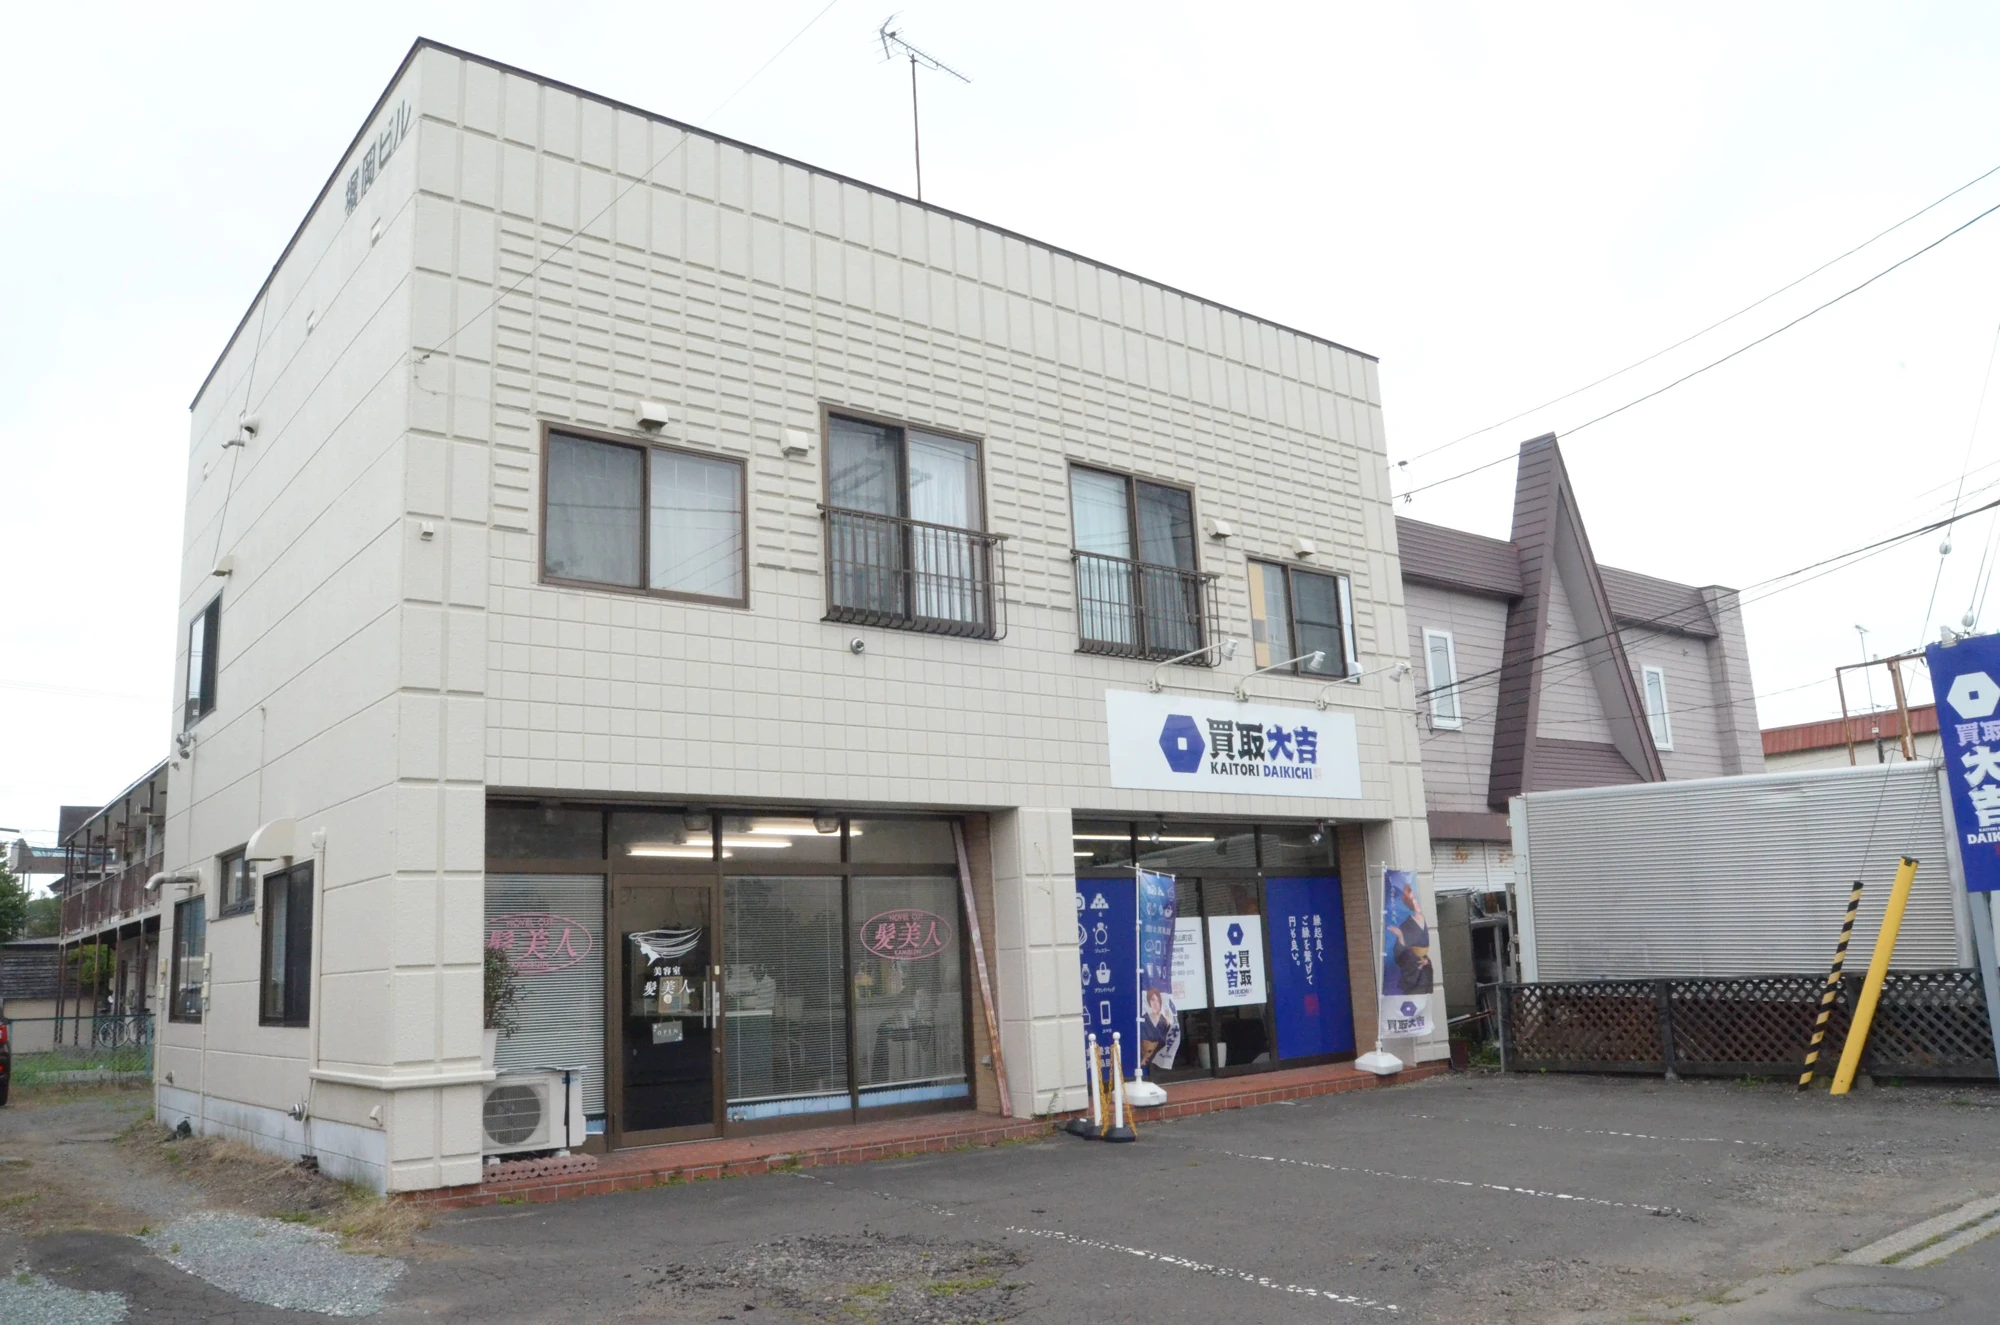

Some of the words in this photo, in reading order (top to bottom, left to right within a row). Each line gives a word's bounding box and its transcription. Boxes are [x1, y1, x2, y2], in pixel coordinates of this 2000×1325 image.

[1206, 718, 1318, 764] 買取大吉
[1955, 720, 2000, 746] 買取
[1211, 761, 1260, 777] KAITORI
[1263, 765, 1313, 780] DAIKICHI
[873, 921, 942, 951] 髪美人
[1313, 914, 1324, 962] 縁起良く
[653, 966, 681, 977] 美容室
[1224, 951, 1238, 988] 大吉
[1238, 950, 1252, 986] 買取
[643, 979, 693, 997] 髪美人
[657, 1028, 679, 1036] OPEN
